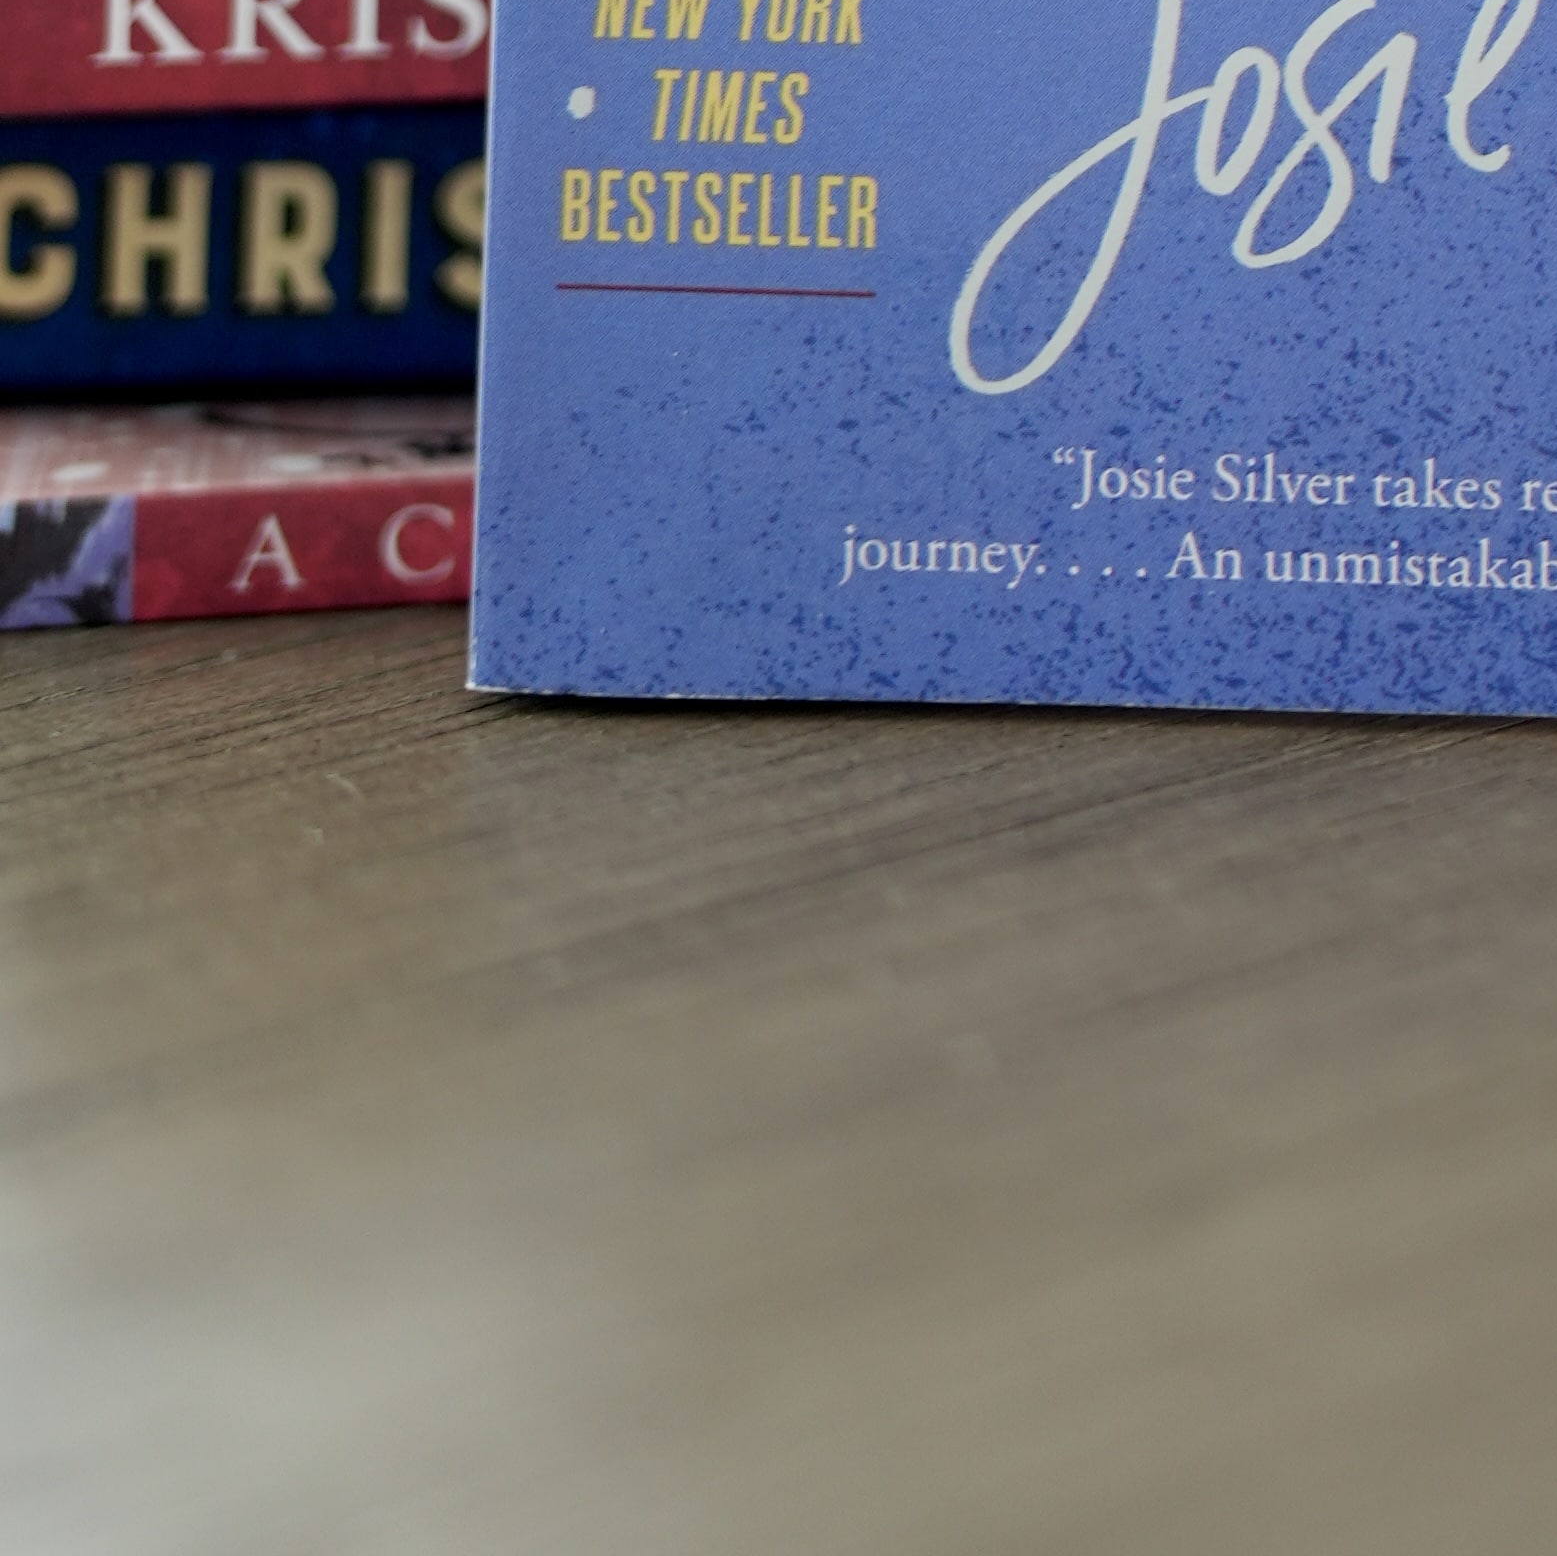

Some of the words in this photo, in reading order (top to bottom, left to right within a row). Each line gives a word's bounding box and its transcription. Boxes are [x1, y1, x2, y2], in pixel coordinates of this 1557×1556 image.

[652, 68, 810, 144] TIMES
[559, 168, 879, 249] BESTSELLER
[1053, 447, 1195, 510] “Josie
[1212, 452, 1355, 507] Silver
[1373, 458, 1500, 510] takes
[232, 514, 306, 594] A
[1165, 531, 1243, 581] An
